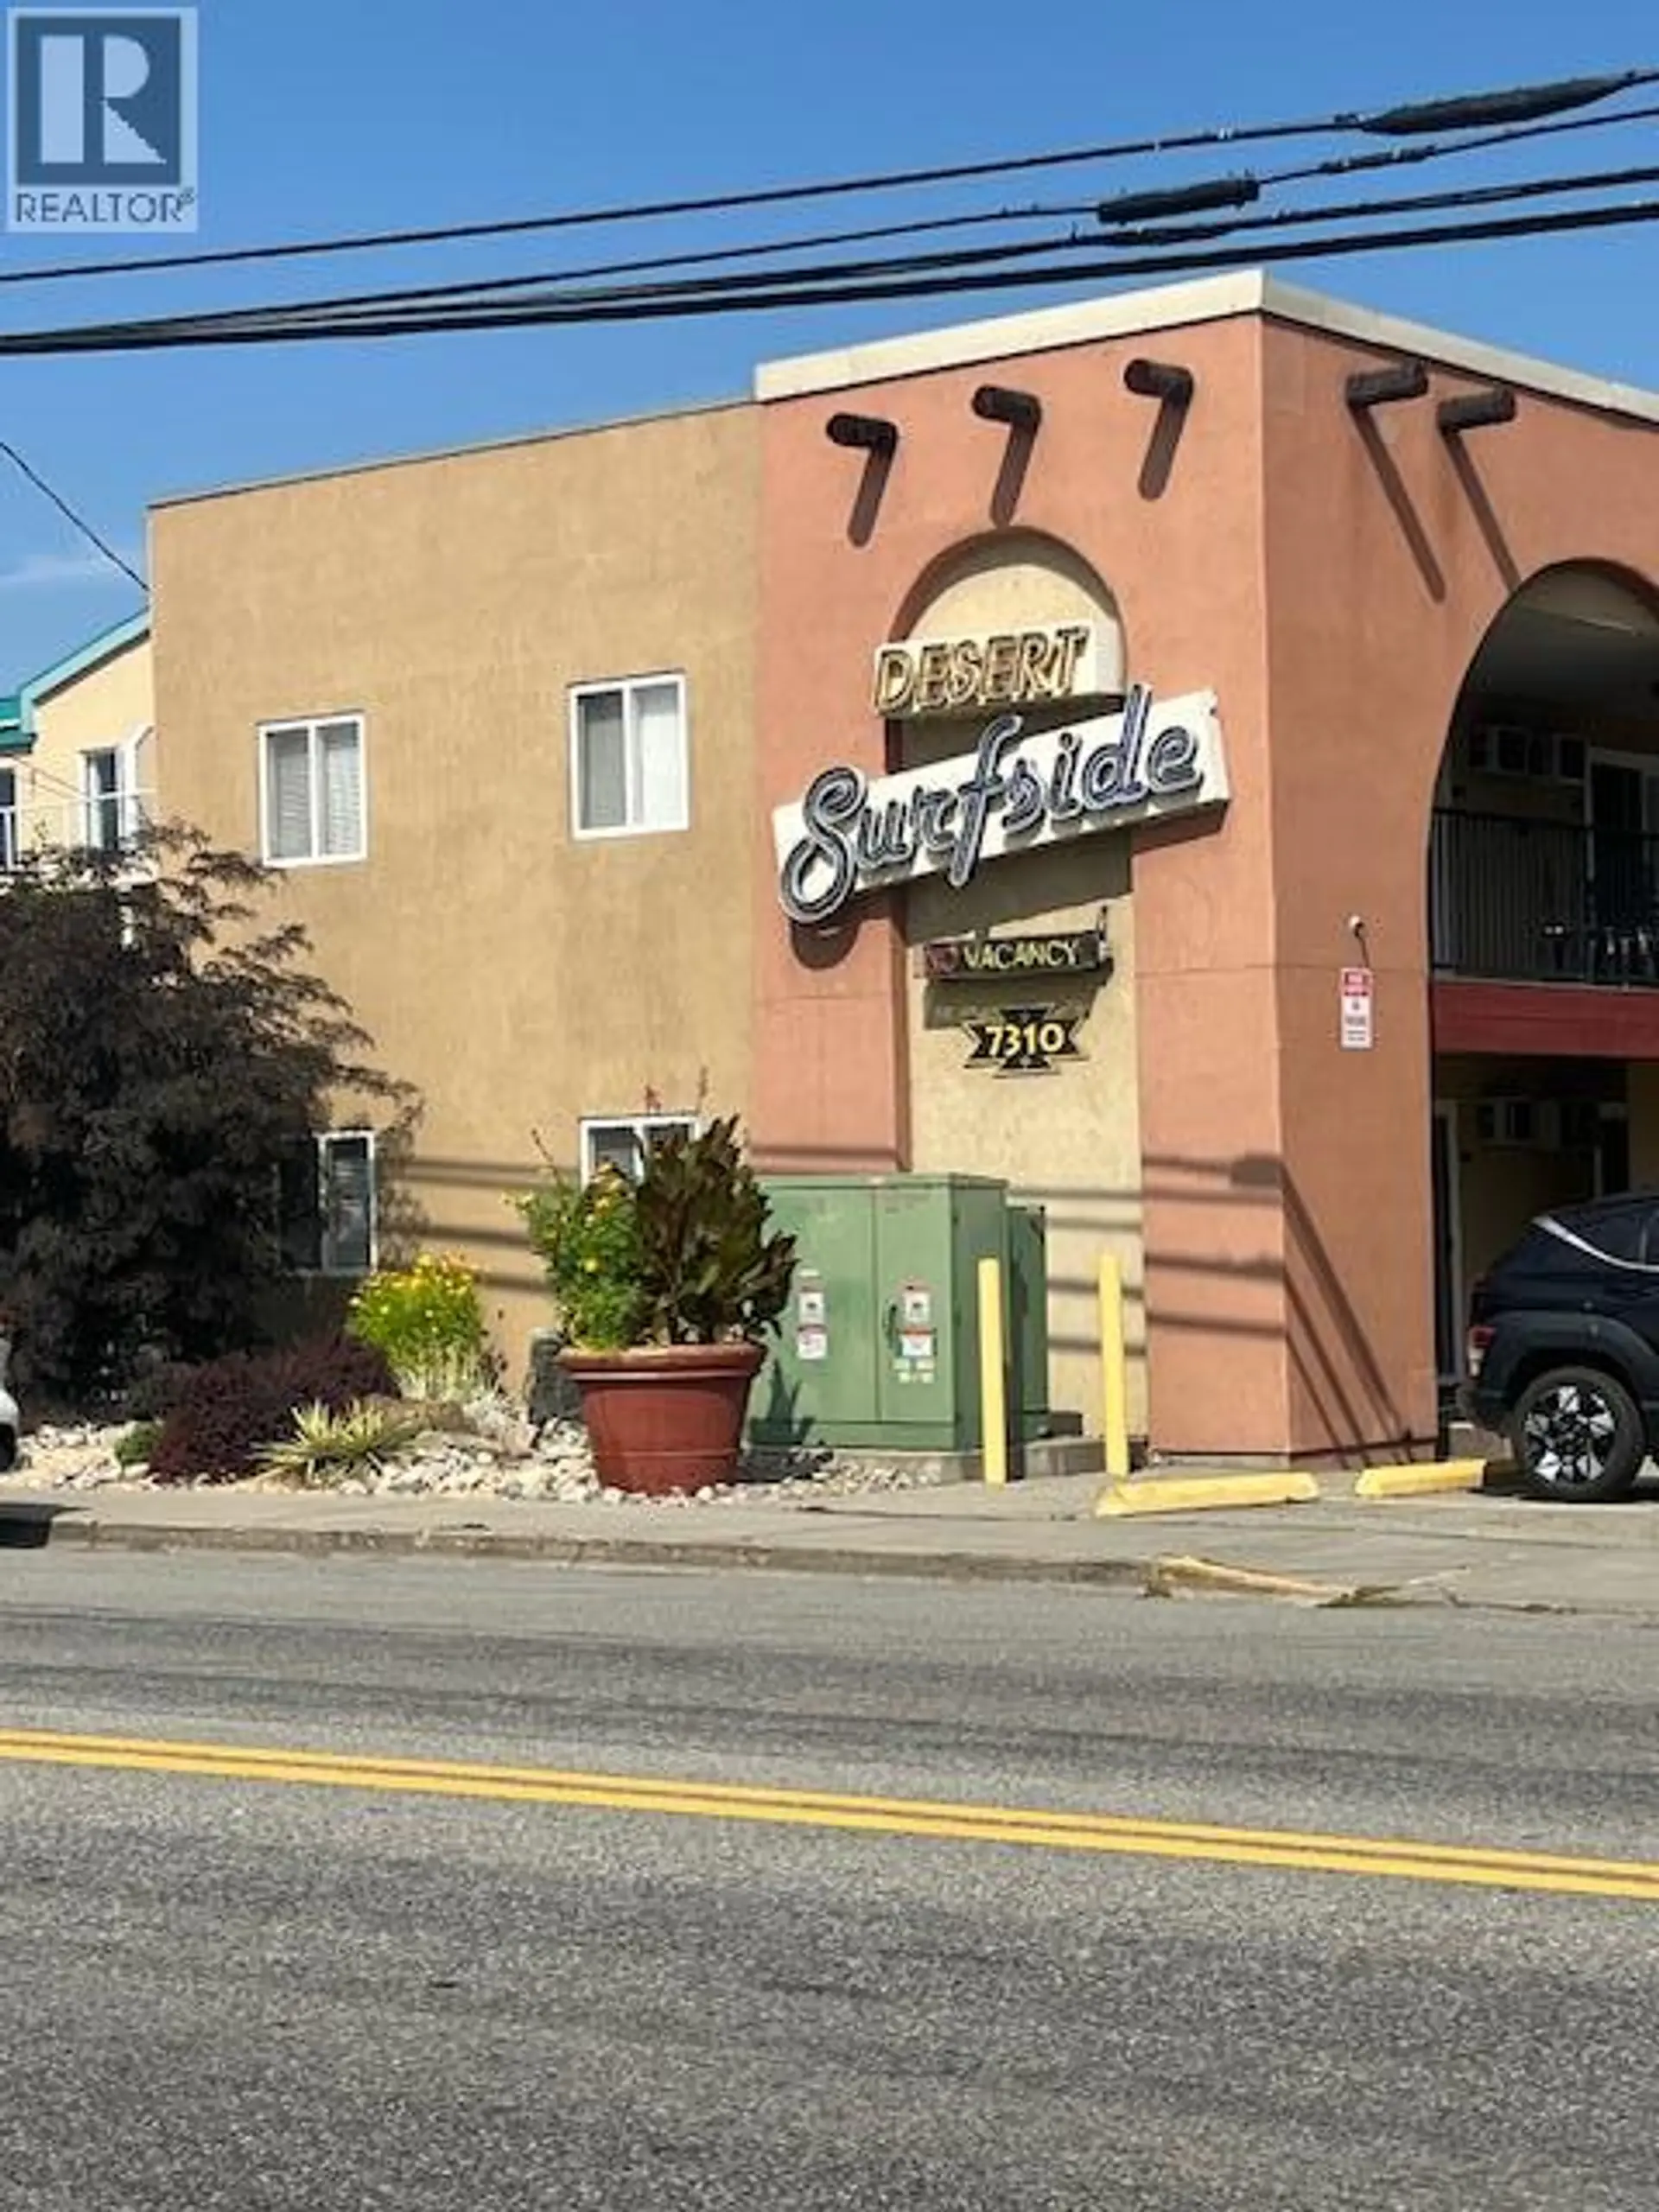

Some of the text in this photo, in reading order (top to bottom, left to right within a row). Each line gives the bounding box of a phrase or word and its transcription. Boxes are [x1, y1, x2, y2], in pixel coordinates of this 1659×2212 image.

[875, 627, 1089, 714] DESERT
[781, 684, 1204, 924] Surfside
[963, 939, 1079, 969] VACANCY
[985, 1023, 1065, 1055] 7310
